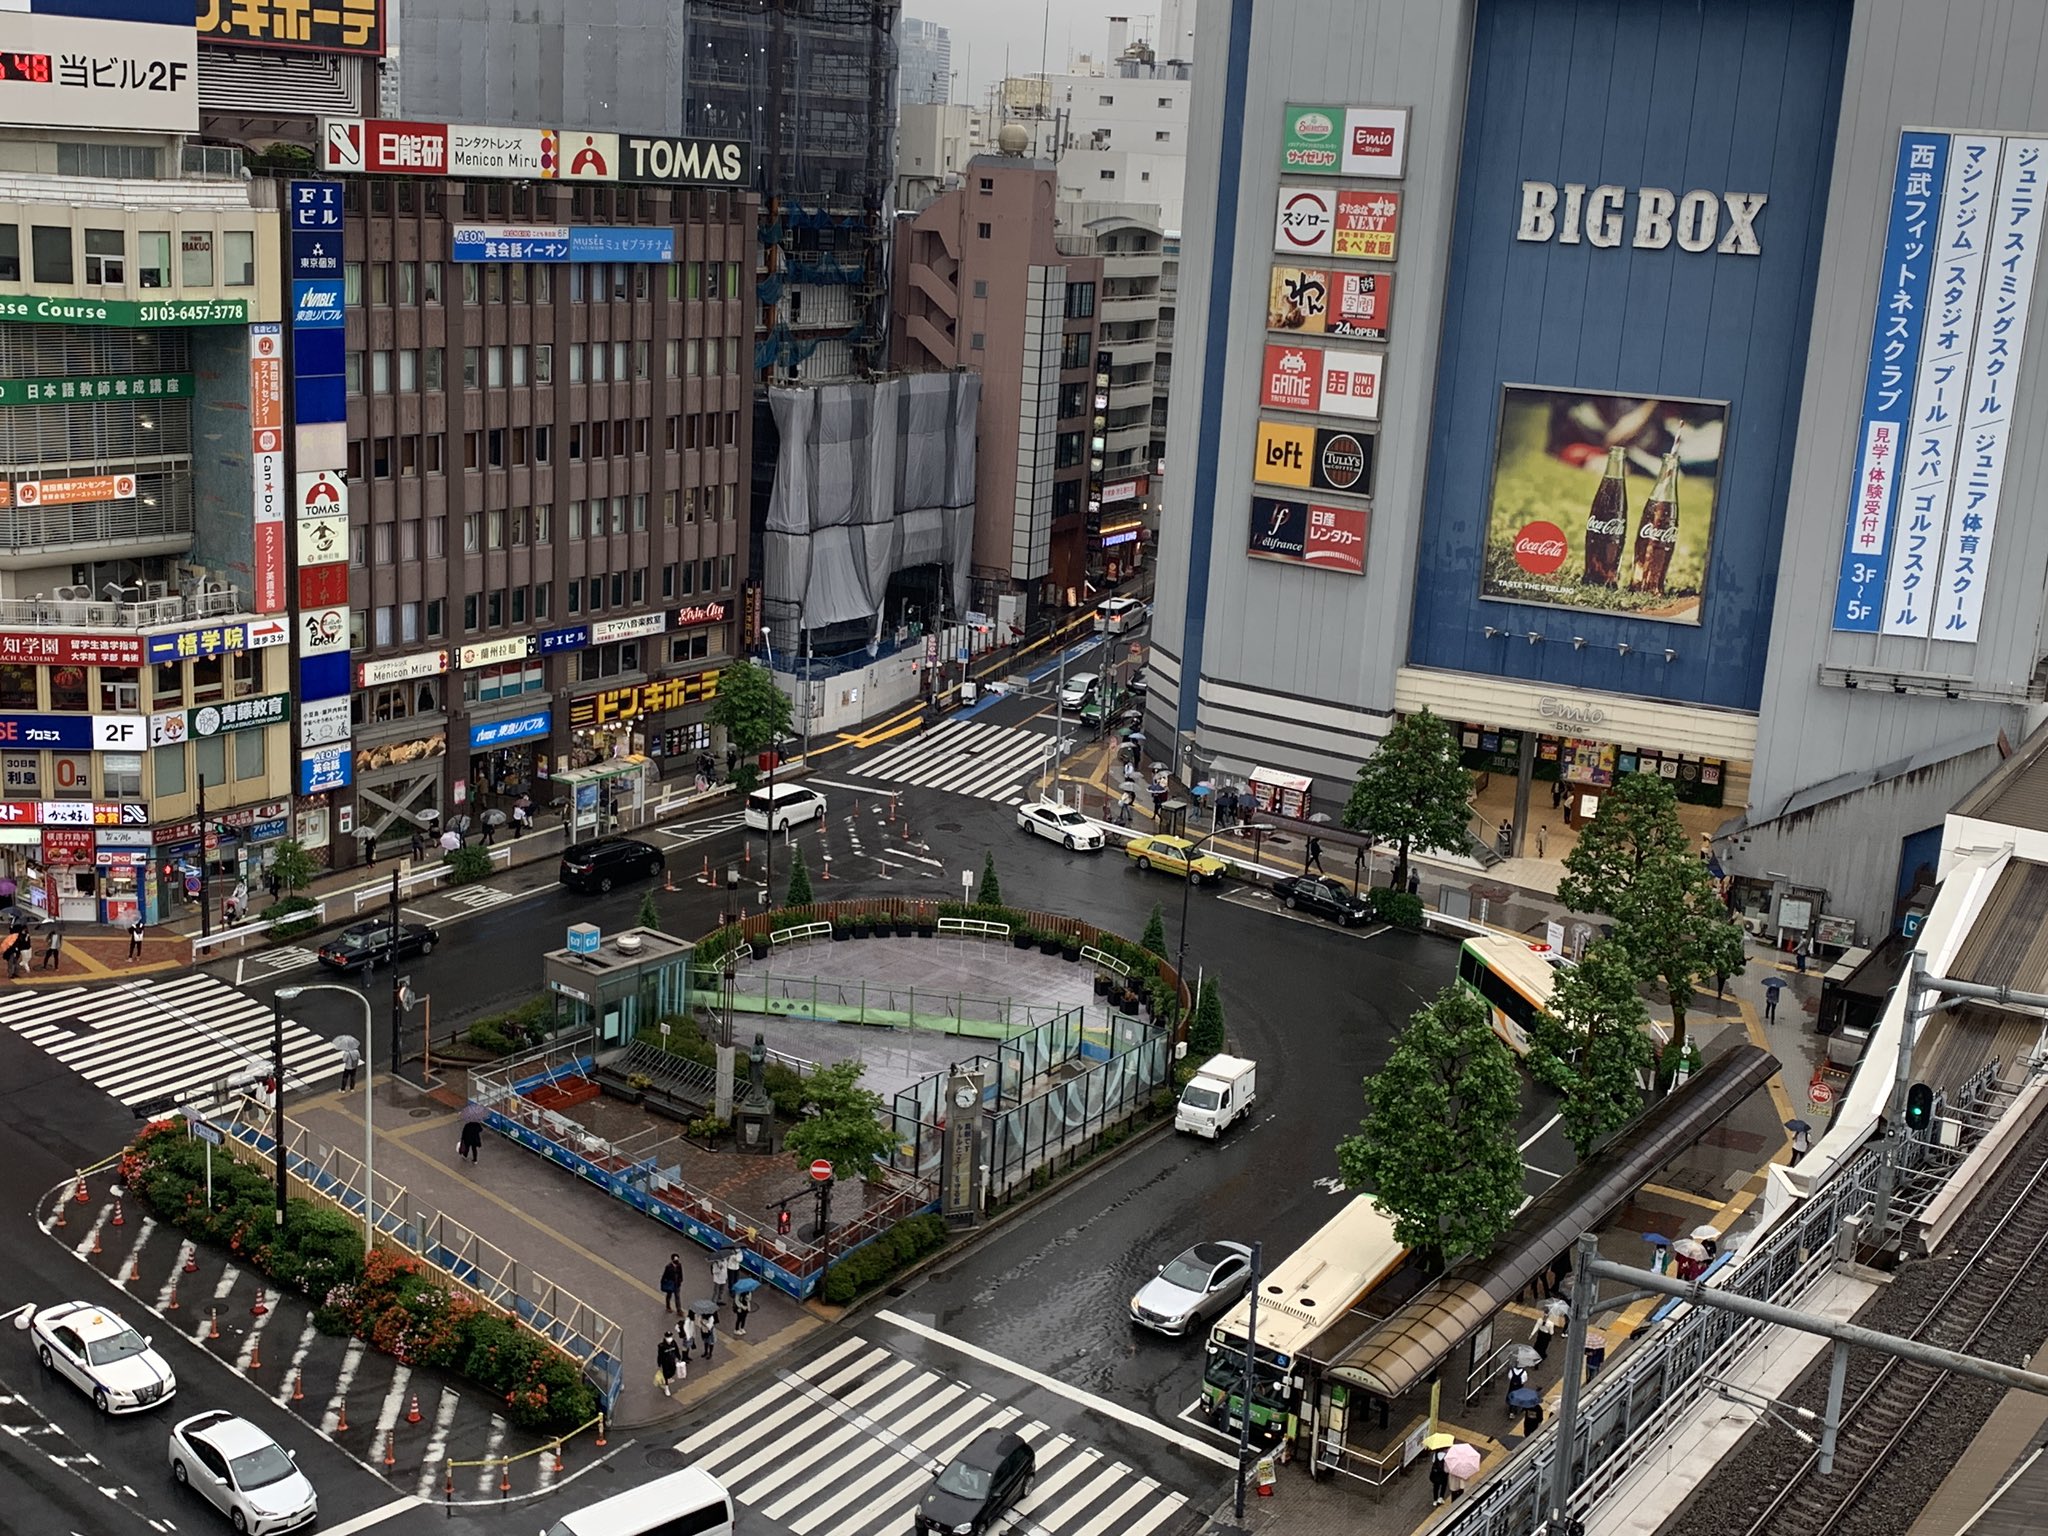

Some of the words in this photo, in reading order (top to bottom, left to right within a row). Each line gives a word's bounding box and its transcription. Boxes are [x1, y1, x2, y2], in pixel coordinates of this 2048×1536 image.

[59, 54, 188, 92] 当ビル2F
[455, 137, 522, 151] コンタクトレンズ
[1356, 129, 1392, 145] Emio
[378, 133, 444, 168] 日能研
[1287, 149, 1336, 166] サイゼリヤ
[455, 151, 504, 169] Menicon
[508, 154, 538, 169] Miru
[629, 139, 742, 181] TOMAS
[299, 188, 334, 204] FI
[299, 208, 339, 226] ビル
[1281, 212, 1330, 227] スシロー
[1346, 215, 1387, 231] NEXT
[1516, 180, 1626, 248] BIG
[1632, 186, 1768, 256] BOX
[456, 231, 486, 244] AEON
[605, 239, 672, 250] ミュゼプラチナム
[485, 242, 568, 259] 英会話イーオン
[1336, 238, 1391, 255] 食べ放題
[300, 257, 336, 269] 東京個別
[1878, 144, 1937, 412] 西武フィットネスクラブ
[37, 301, 107, 320] Course
[160, 304, 244, 321] 03-6457-3778
[295, 309, 343, 322] 東急リバブル
[27, 377, 180, 400] 日本語教師養成講座
[260, 360, 269, 425] テストセンター
[1271, 373, 1312, 398] GAME
[1860, 427, 1891, 549] 見学・体験受付中
[305, 504, 340, 516] TOMAS
[1311, 510, 1336, 527] 日産
[1310, 526, 1362, 545] レンタカー
[1515, 537, 1565, 558] Coca-Cola
[607, 614, 662, 633] ヤマハ音楽教室
[3, 636, 60, 655] 知学園
[152, 626, 244, 657] 一橋学院
[253, 633, 285, 646] 徒歩3分
[373, 667, 408, 682] Menicon
[411, 663, 433, 675] Miru
[1538, 696, 1605, 724] Emio
[25, 728, 61, 741] プロミス
[105, 724, 135, 742] 2F
[312, 759, 340, 773] 英会話
[7, 771, 37, 785] 利息
[310, 770, 345, 785] イーオン
